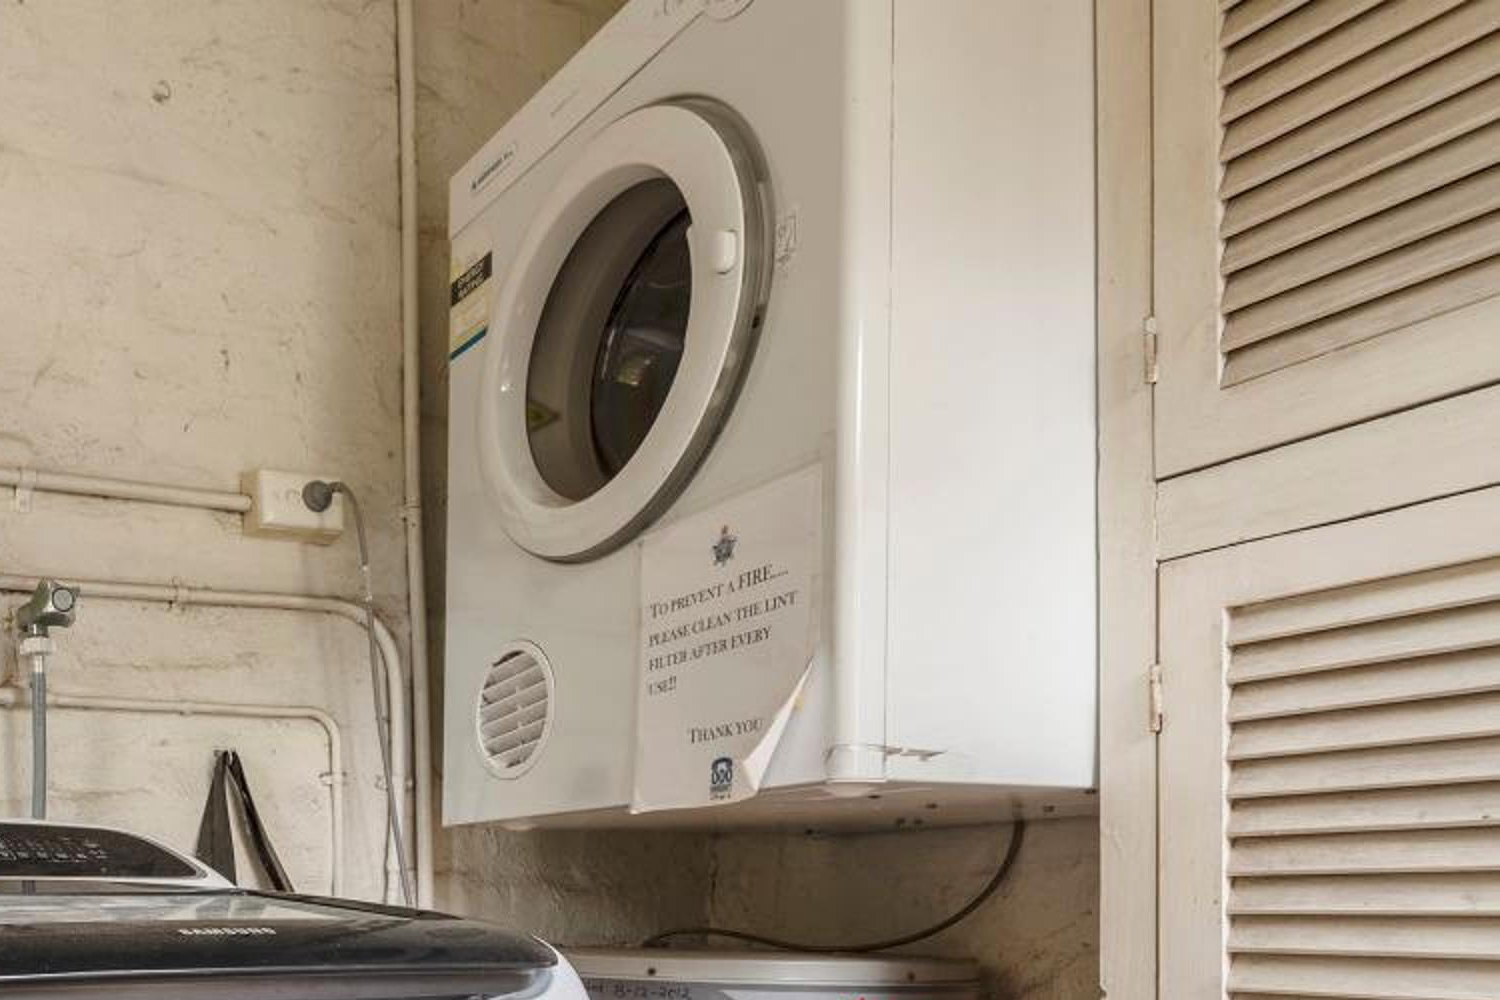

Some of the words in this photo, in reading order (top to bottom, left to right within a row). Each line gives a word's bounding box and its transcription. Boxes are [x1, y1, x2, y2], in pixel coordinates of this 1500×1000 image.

[649, 624, 692, 647] PLEASE
[690, 612, 731, 634] CLEAN
[733, 603, 761, 621] THE
[764, 590, 799, 612] LINT
[650, 603, 669, 619] TO
[670, 583, 725, 612] PREVENT
[727, 581, 735, 592] A
[649, 651, 688, 671] FILTER
[688, 639, 728, 660] AFTER
[730, 626, 772, 649] EVERY
[689, 723, 733, 744] THANK
[734, 718, 763, 735] YOU
